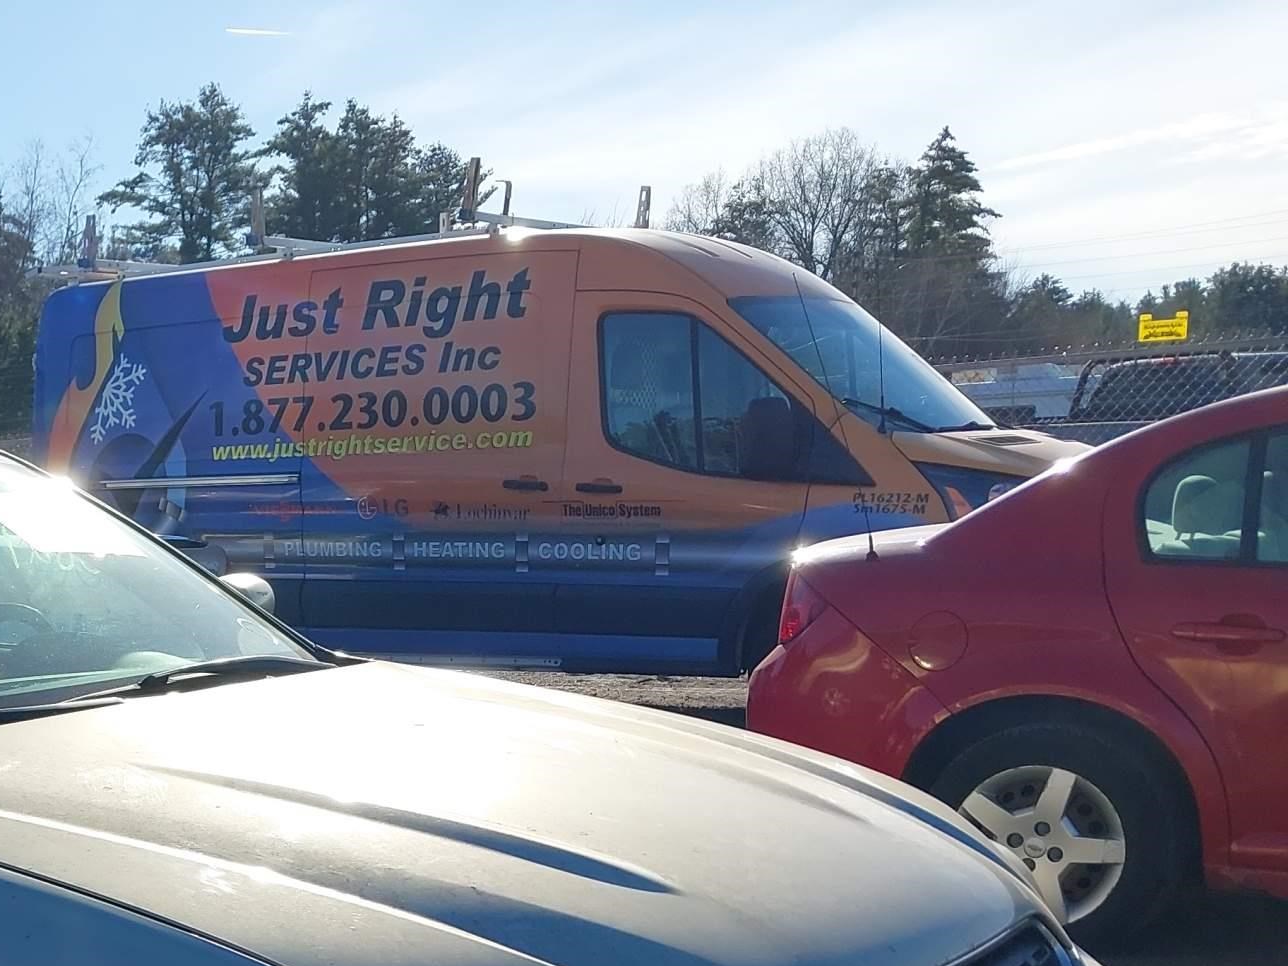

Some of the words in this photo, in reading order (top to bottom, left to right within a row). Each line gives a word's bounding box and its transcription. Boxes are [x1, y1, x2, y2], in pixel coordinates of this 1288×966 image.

[222, 286, 344, 343] Just
[362, 267, 532, 339] Right
[243, 343, 427, 387] SERVICES
[438, 341, 501, 373] Inc
[209, 381, 537, 437] 1.877.230.0003
[212, 429, 532, 462] www.justrightservice.com
[284, 542, 382, 557] PLUMBING
[414, 542, 505, 558] HEATING
[538, 543, 641, 561] COOLING
